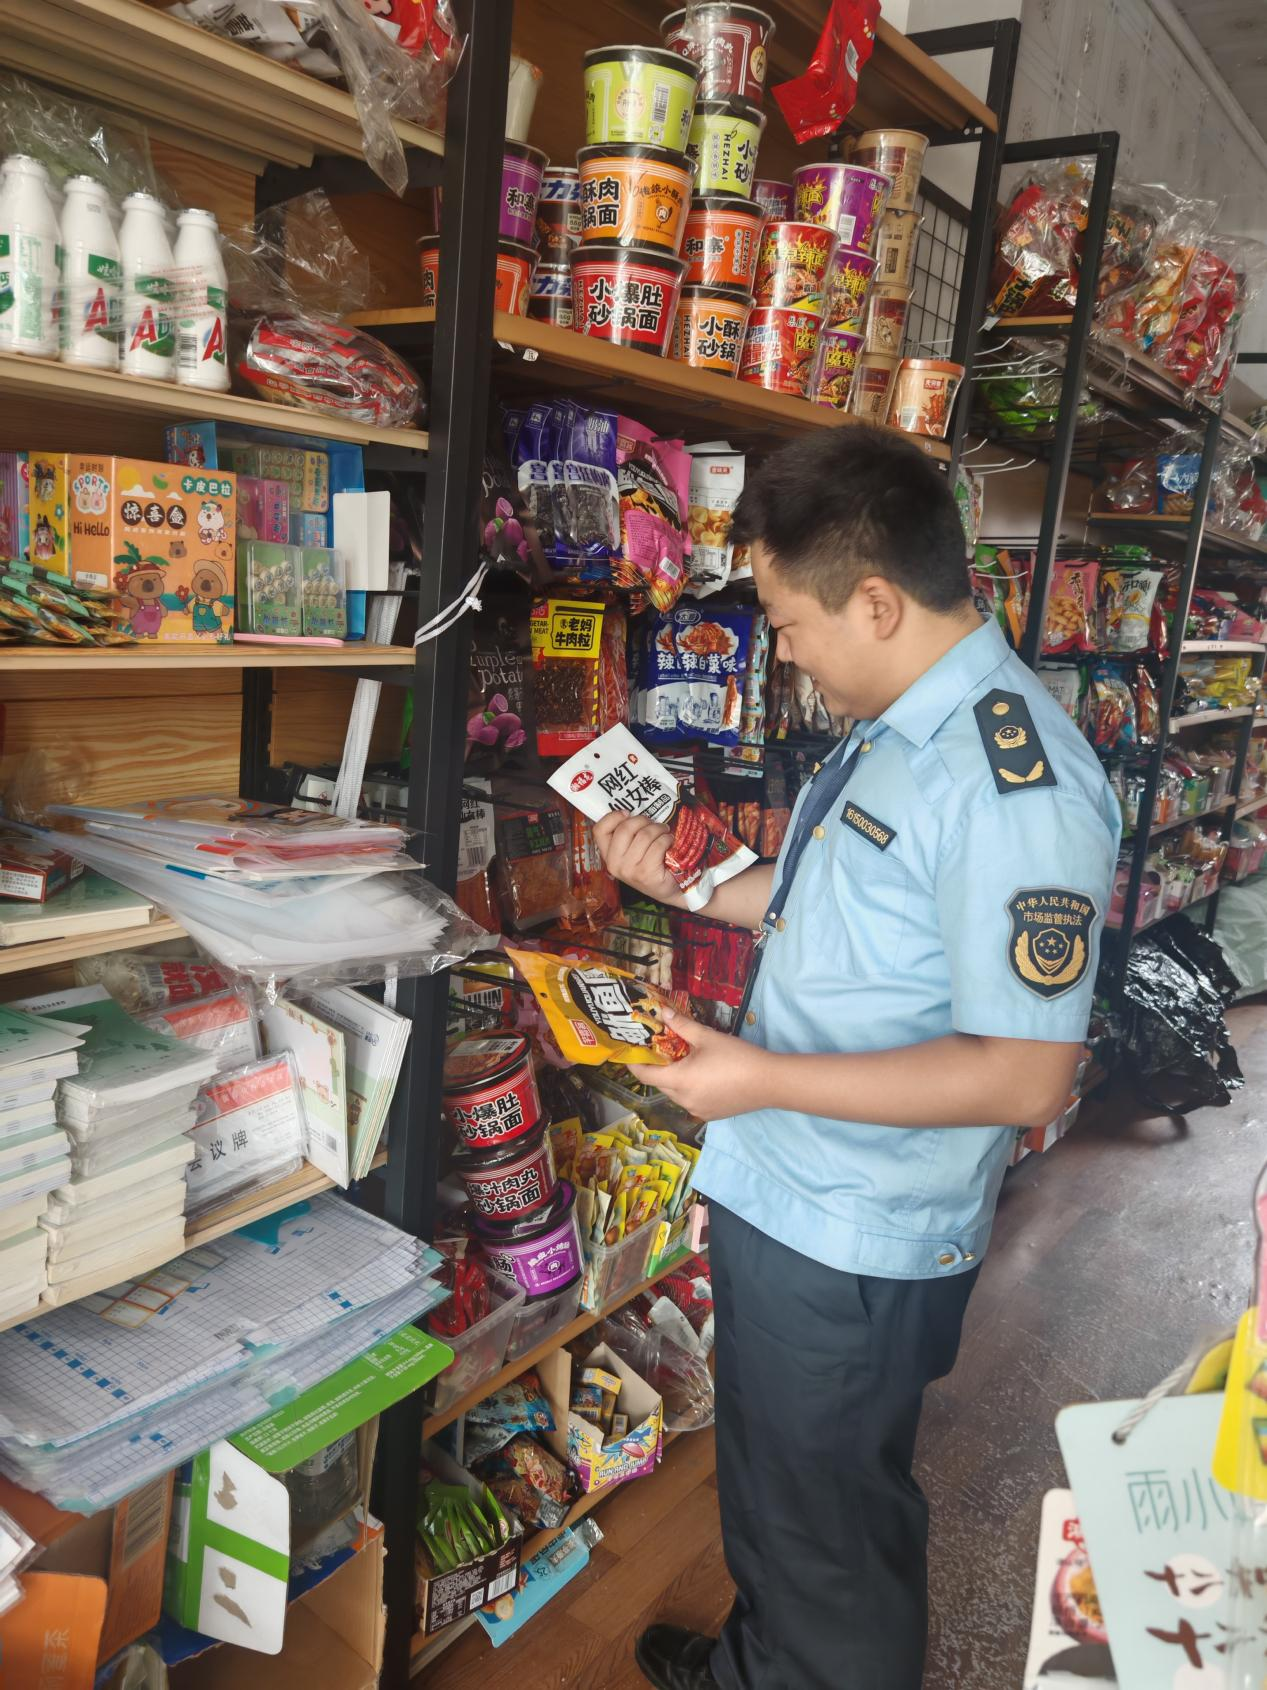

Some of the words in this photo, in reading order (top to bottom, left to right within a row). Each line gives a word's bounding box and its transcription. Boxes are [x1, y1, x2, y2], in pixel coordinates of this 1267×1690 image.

[721, 133, 732, 180] HEZHAI
[73, 475, 109, 495] SPORTS
[183, 478, 232, 497] 卡皮巴拉
[124, 501, 185, 526] 惊喜盒
[73, 521, 83, 535] Hi
[84, 522, 110, 537] Hello
[568, 618, 593, 633] 老妈
[554, 632, 592, 647] 牛肉粒
[681, 652, 738, 675] 辣白菜味
[597, 761, 639, 798] 网红
[846, 807, 889, 845] 16150030568
[1015, 895, 1091, 916] 中华人民共和国
[453, 1092, 520, 1124] 小爆肚
[456, 1110, 523, 1140] 砂锅面
[467, 1168, 539, 1197] 爆汁肉丸
[473, 1183, 541, 1215] 砂锅面
